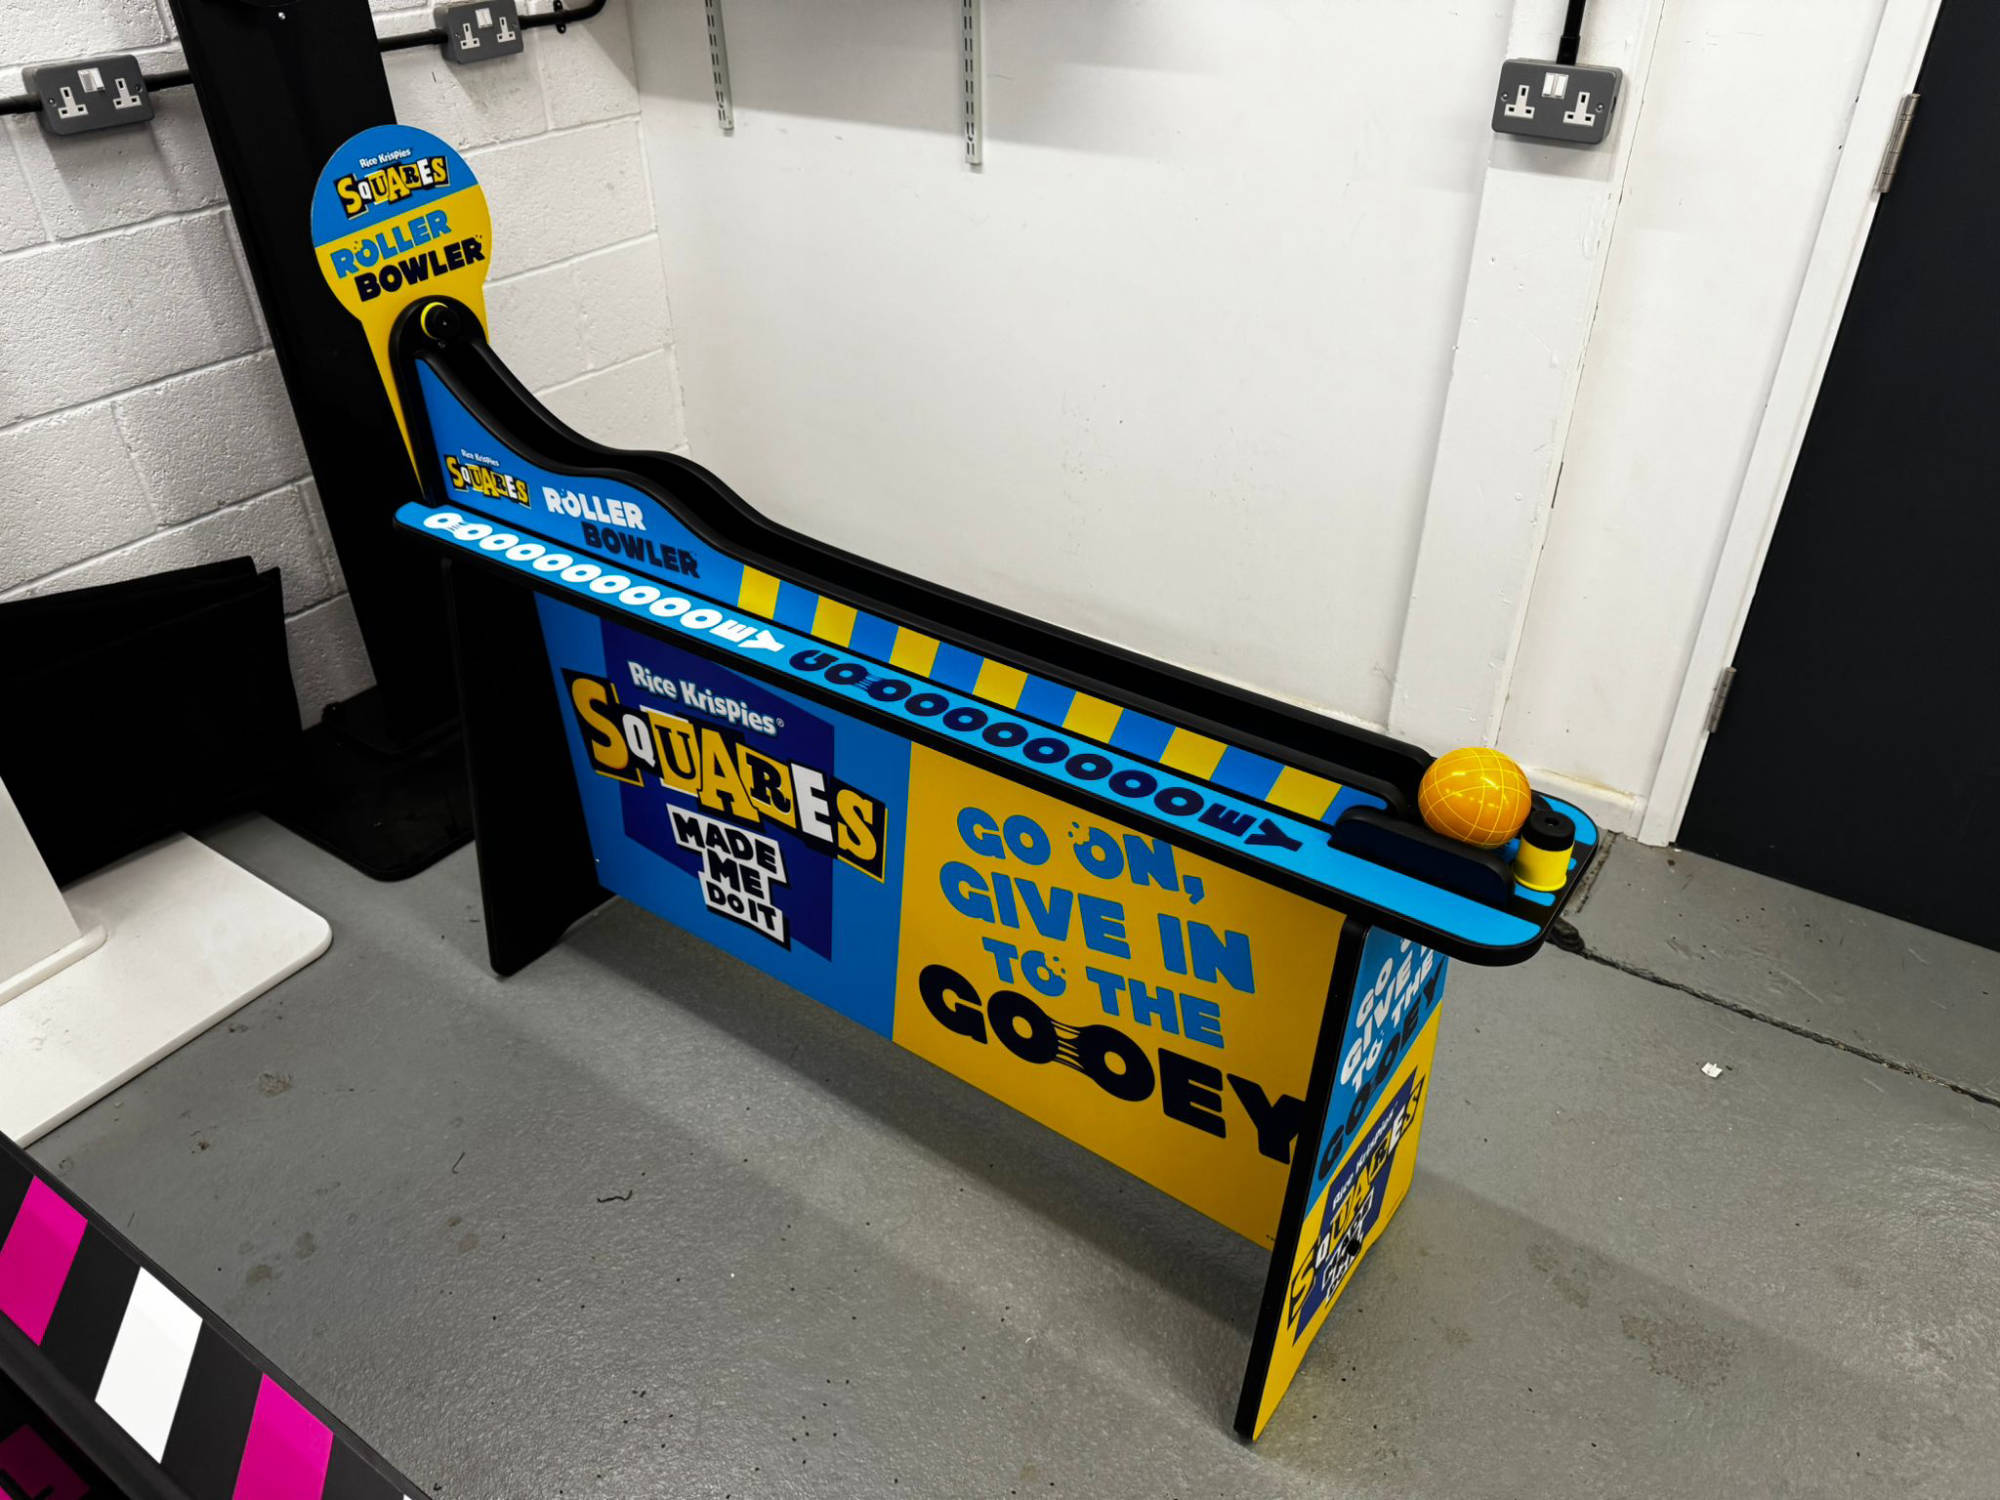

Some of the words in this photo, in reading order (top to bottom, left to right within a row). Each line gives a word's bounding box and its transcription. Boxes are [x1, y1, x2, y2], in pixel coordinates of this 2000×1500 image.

[335, 156, 449, 216] SQUARES
[359, 157, 378, 168] Rice
[330, 210, 451, 279] ROLLER
[354, 236, 485, 302] BOWLER
[445, 456, 529, 506] SQUARES
[542, 486, 647, 531] ROLLER
[581, 521, 700, 579] BOWLER
[628, 660, 678, 699] Rice
[566, 674, 884, 872] SQUARES
[672, 811, 778, 875] MADE
[707, 850, 764, 900] ME
[957, 806, 1052, 866] GO
[1069, 822, 1205, 905] ON,
[707, 882, 745, 914] DO
[749, 898, 778, 932] IT
[939, 861, 1131, 960] GIVE
[1157, 913, 1255, 994] IN
[981, 936, 1067, 997] TO
[1085, 966, 1224, 1049] THE
[1340, 949, 1413, 1085] GIVE
[1355, 957, 1393, 1029] GO
[1391, 949, 1434, 1029] THE
[918, 963, 1306, 1165] GOOEY
[1318, 955, 1446, 1181] GOOEY
